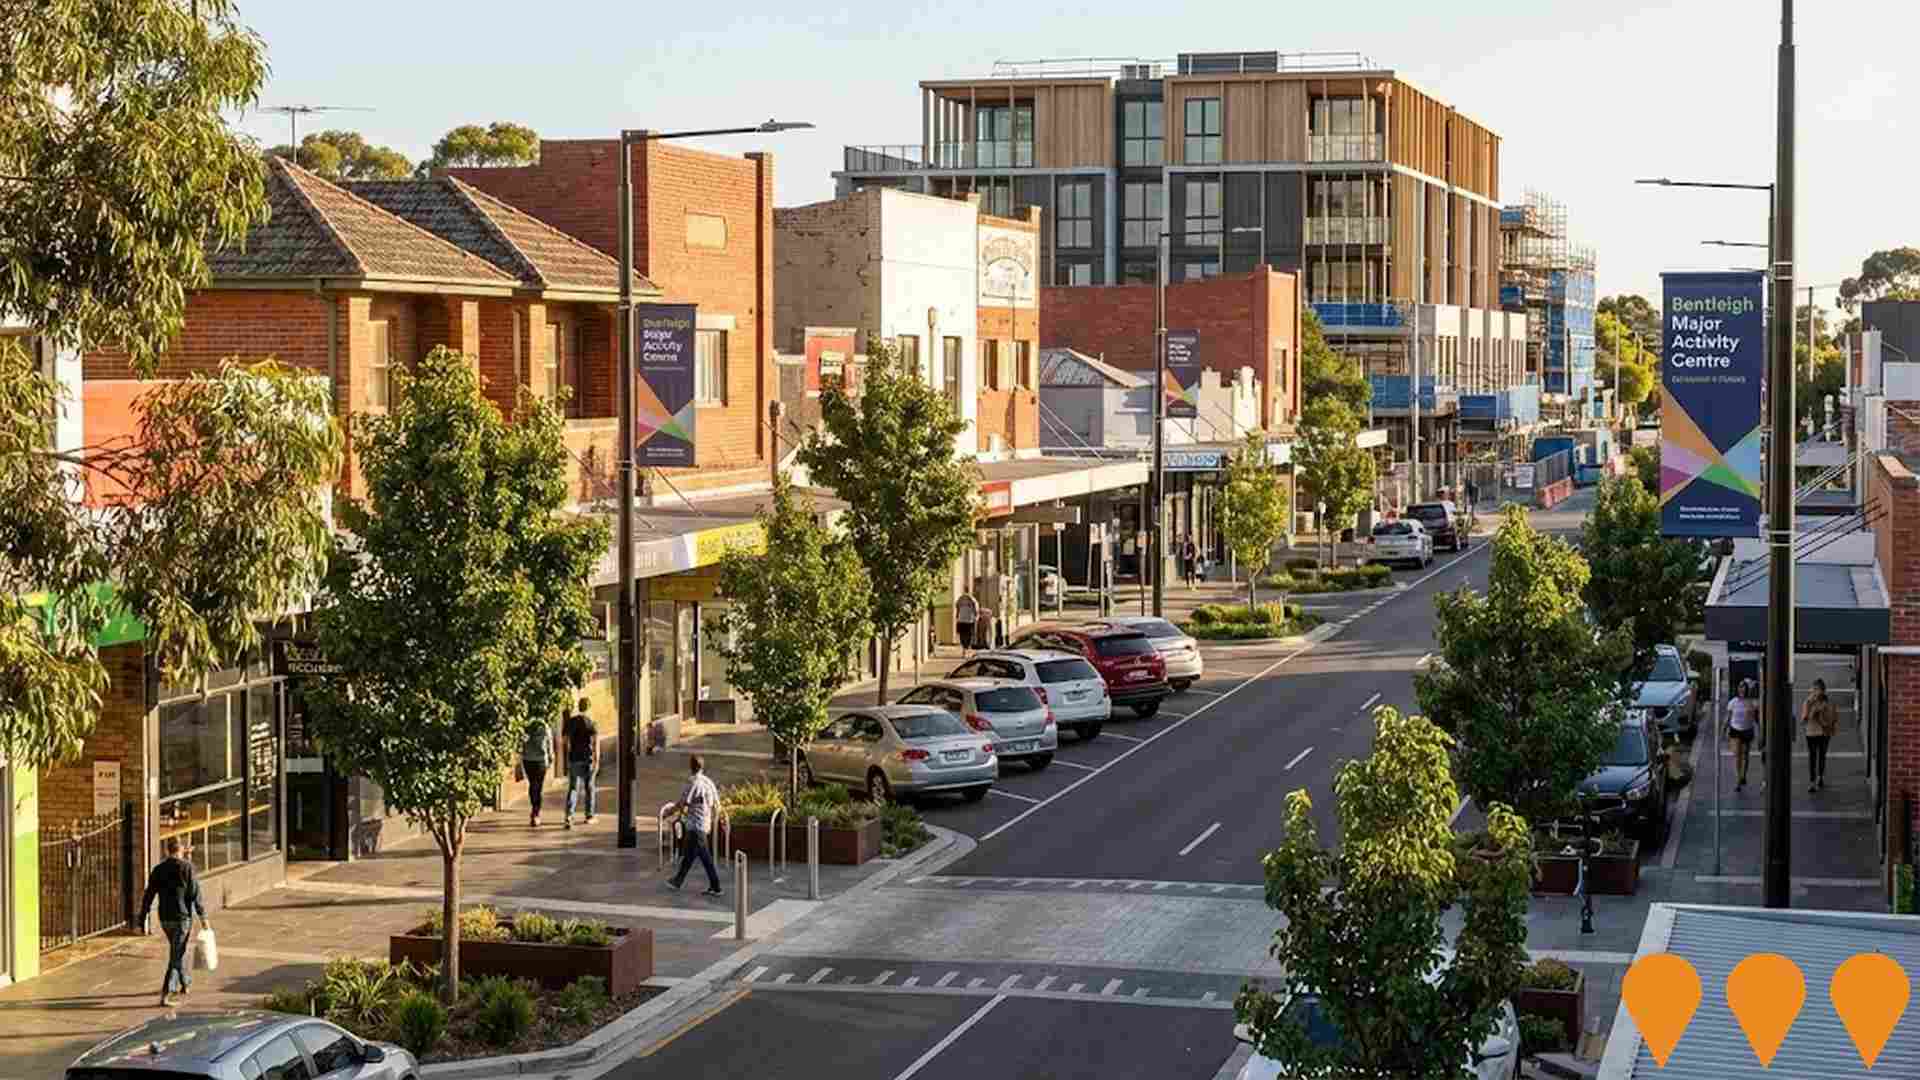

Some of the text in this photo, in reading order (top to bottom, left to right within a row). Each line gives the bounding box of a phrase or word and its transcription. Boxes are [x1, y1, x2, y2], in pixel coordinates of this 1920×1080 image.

[1672, 296, 1754, 314] Bentleigh
[1672, 315, 1722, 334] Major
[1672, 334, 1740, 353] Activity
[1672, 353, 1731, 368] Centre
